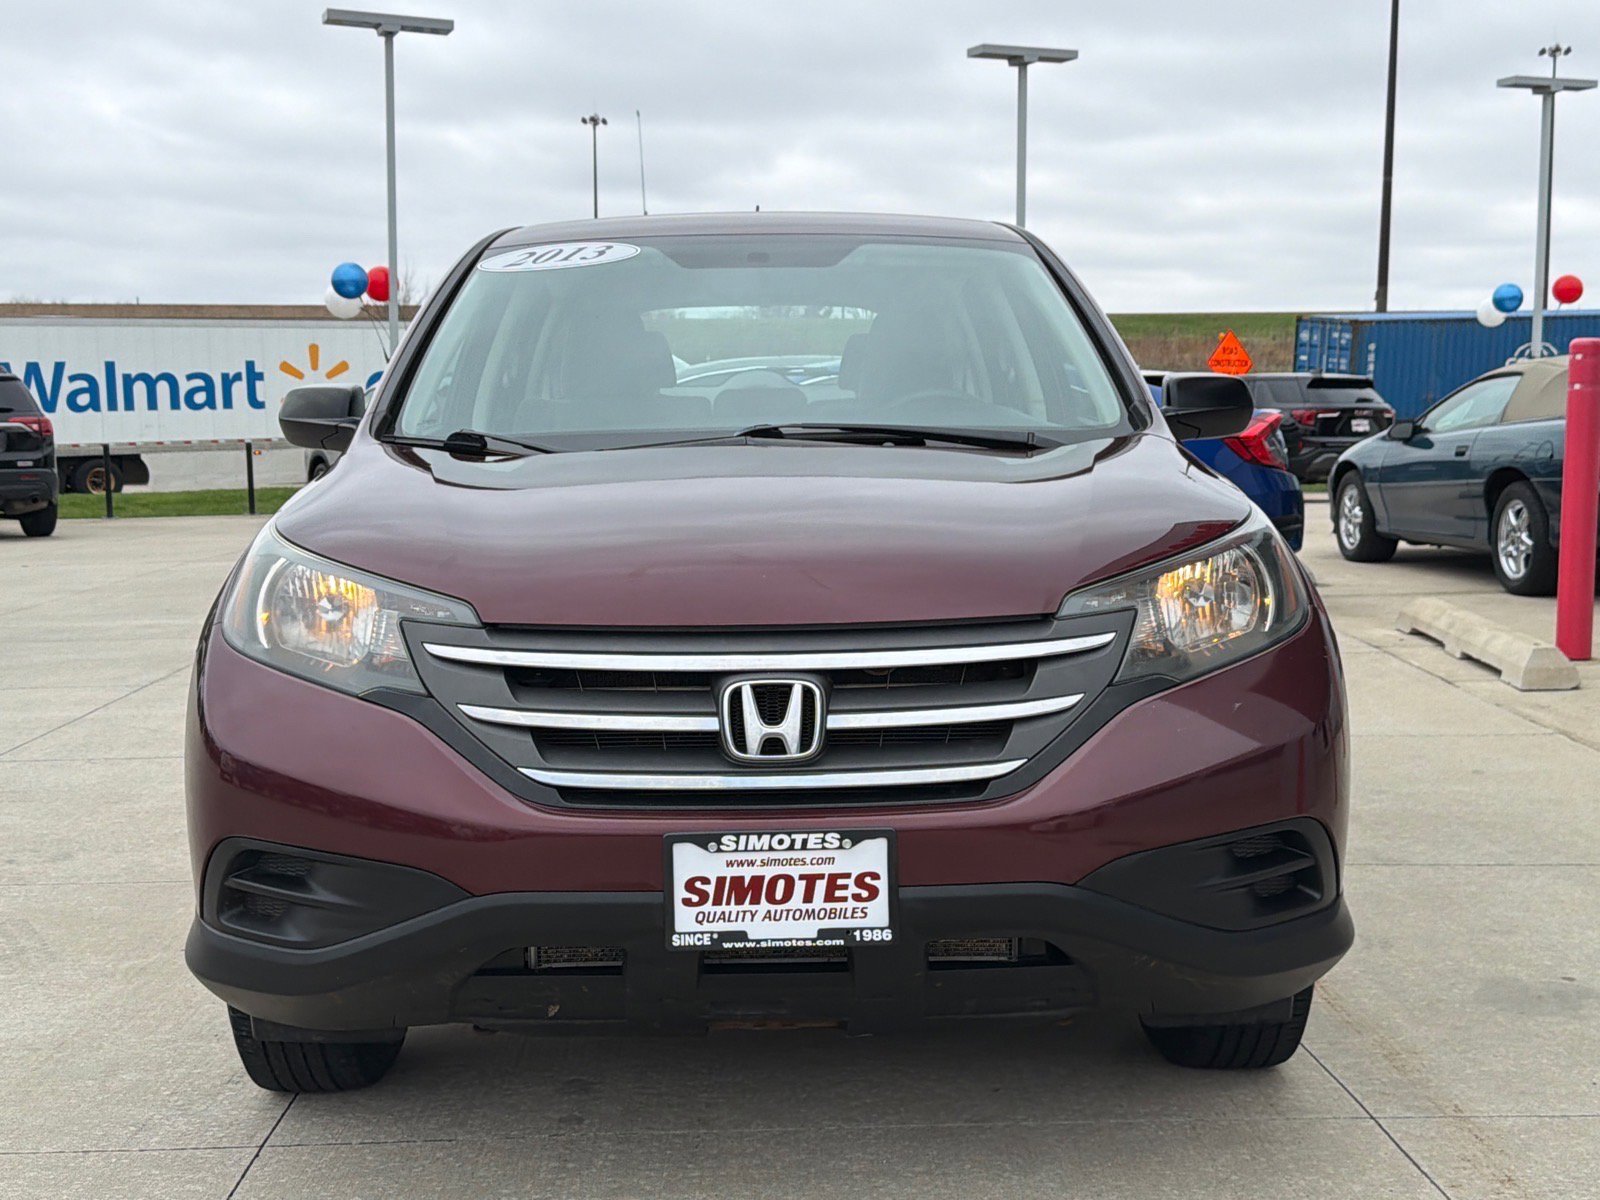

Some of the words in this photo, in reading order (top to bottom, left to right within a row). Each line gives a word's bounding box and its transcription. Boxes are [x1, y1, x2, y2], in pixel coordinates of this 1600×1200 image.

[504, 245, 614, 268] 2013
[0, 360, 266, 414] Walmart
[719, 832, 841, 852] SIMOTES
[725, 856, 836, 869] www.simotes.com
[681, 871, 882, 908] SIMOTES
[694, 909, 759, 924] QUALITY
[762, 906, 869, 922] AUTOMOBILES
[671, 933, 712, 947] SINCE
[852, 929, 893, 942] 1986
[722, 937, 845, 949] www.simotes.com
